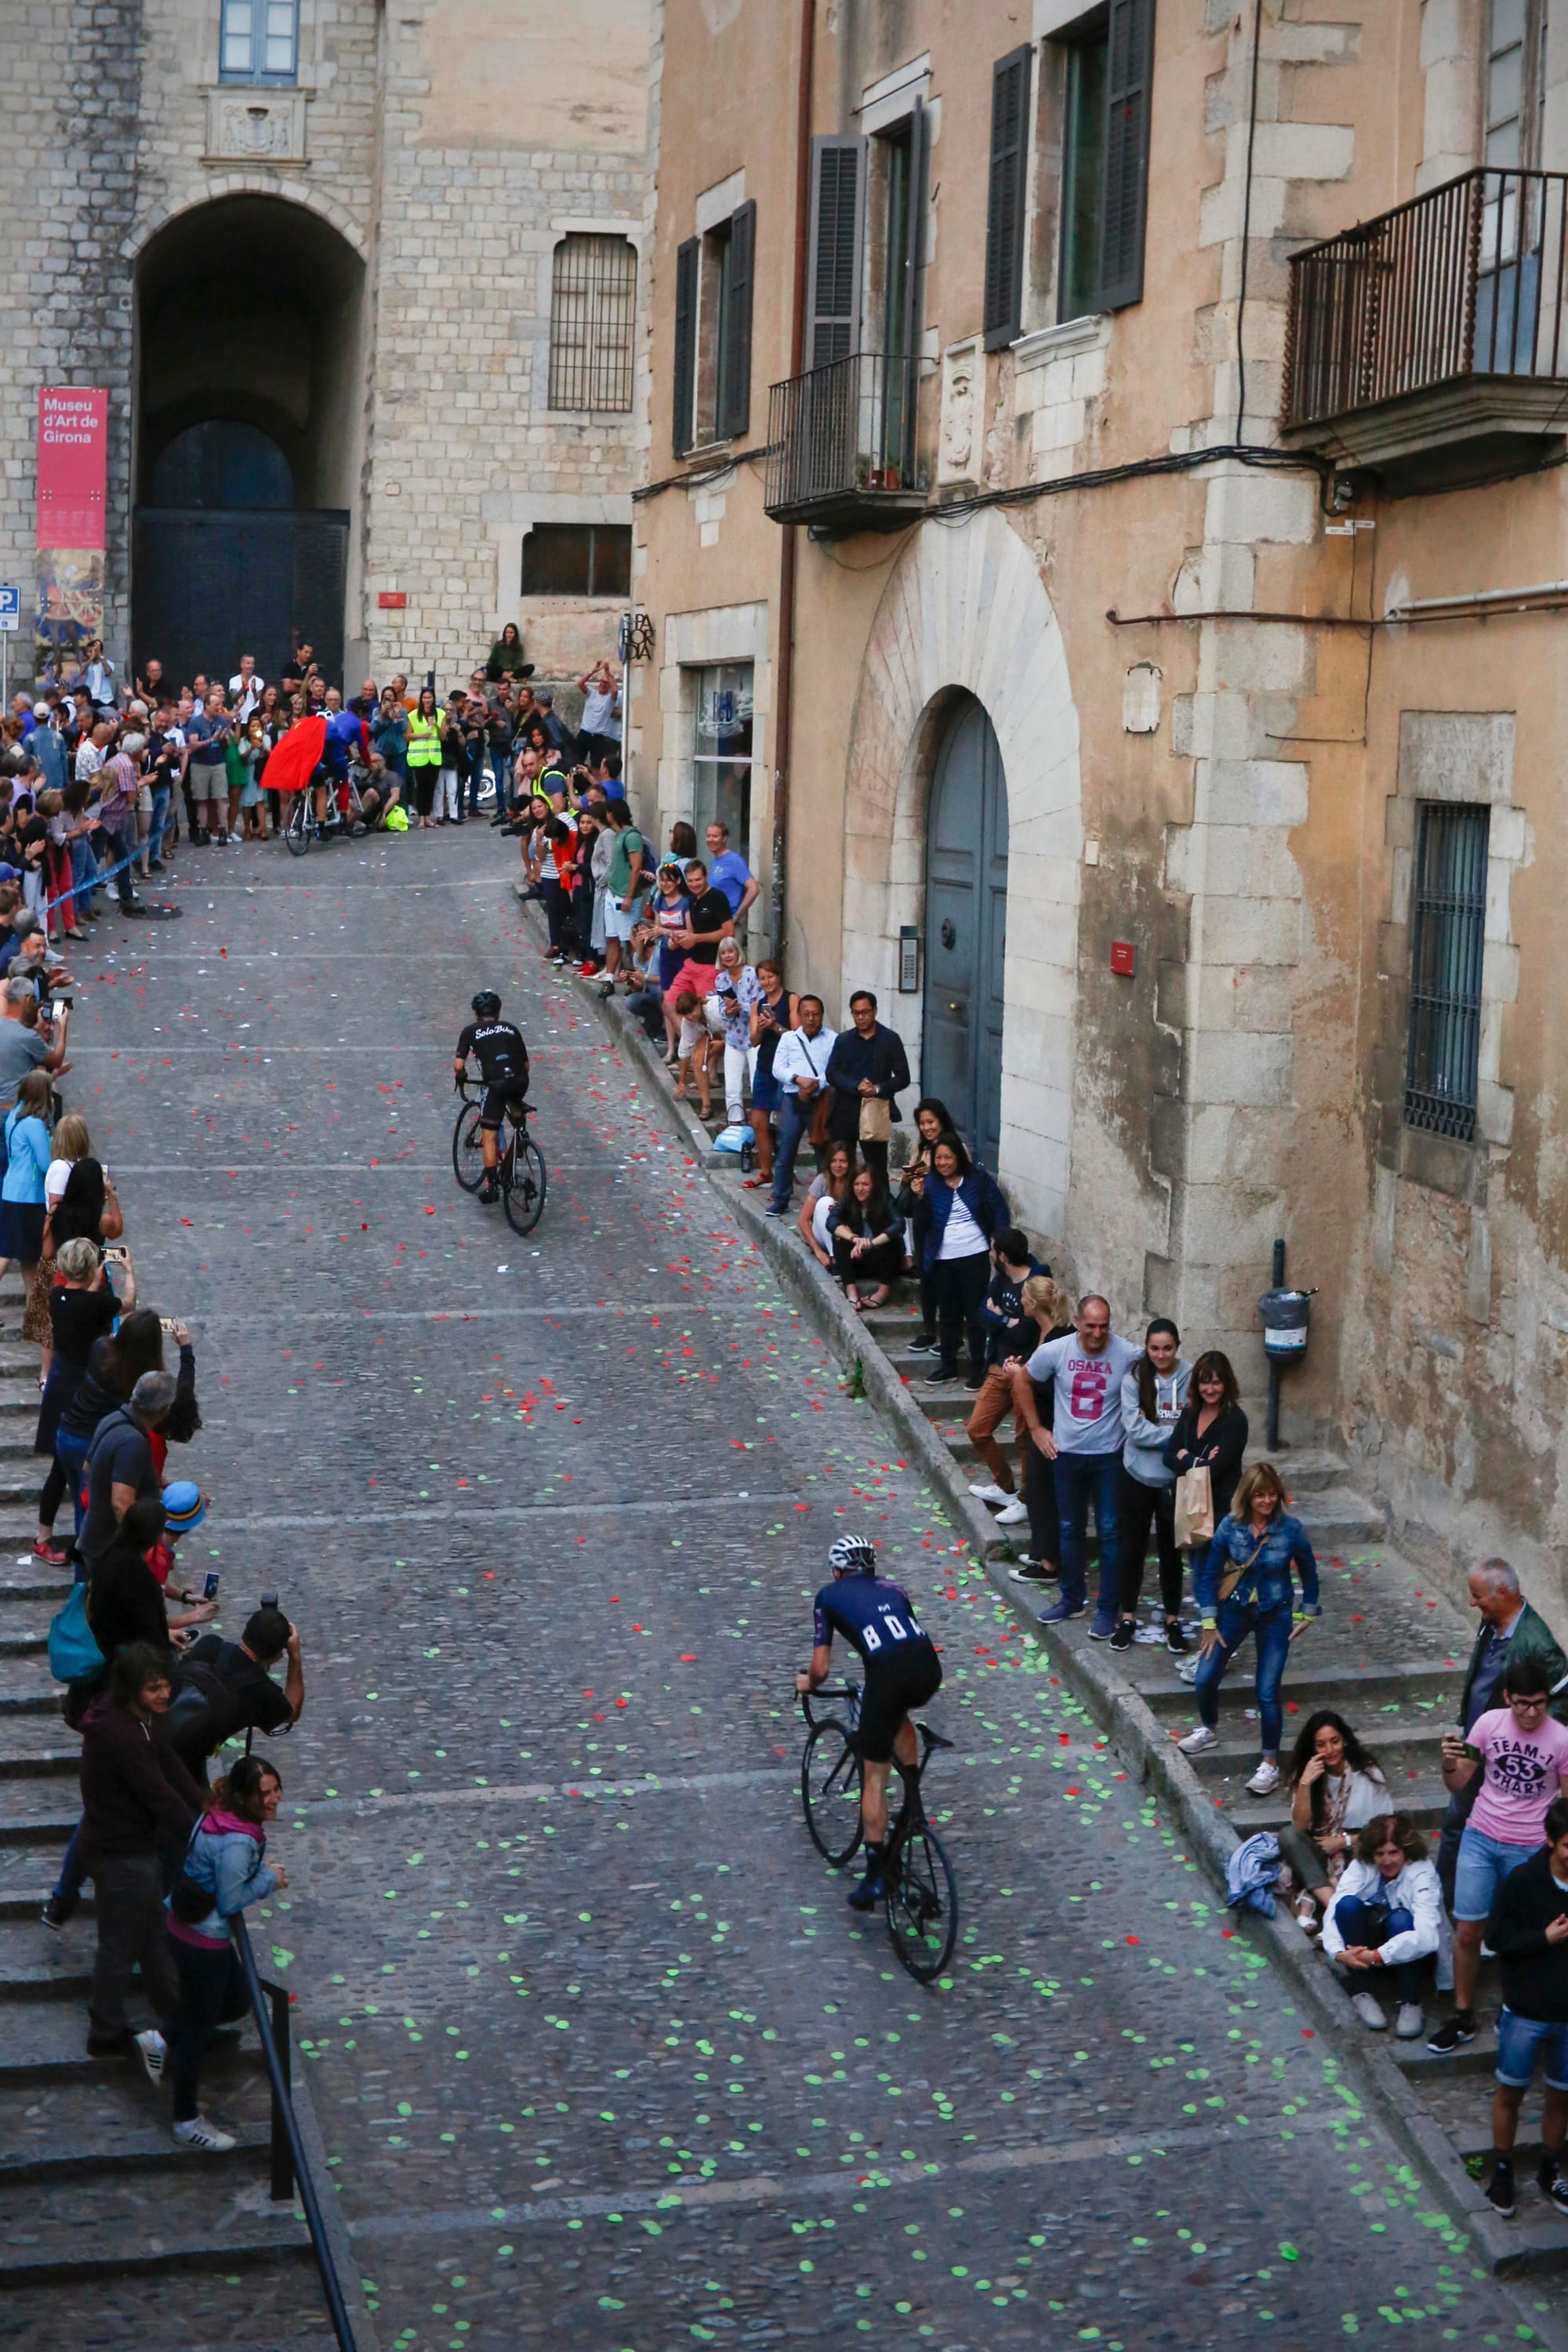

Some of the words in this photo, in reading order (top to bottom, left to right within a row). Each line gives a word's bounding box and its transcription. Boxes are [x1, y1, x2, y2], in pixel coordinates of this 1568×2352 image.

[44, 398, 92, 412] Museu
[43, 414, 78, 427] d'Art
[81, 414, 99, 428] de
[43, 430, 92, 444] Girona
[1068, 1359, 1112, 1374] OSAKA
[1071, 1371, 1106, 1420] 6
[1506, 1755, 1535, 1780] 53
